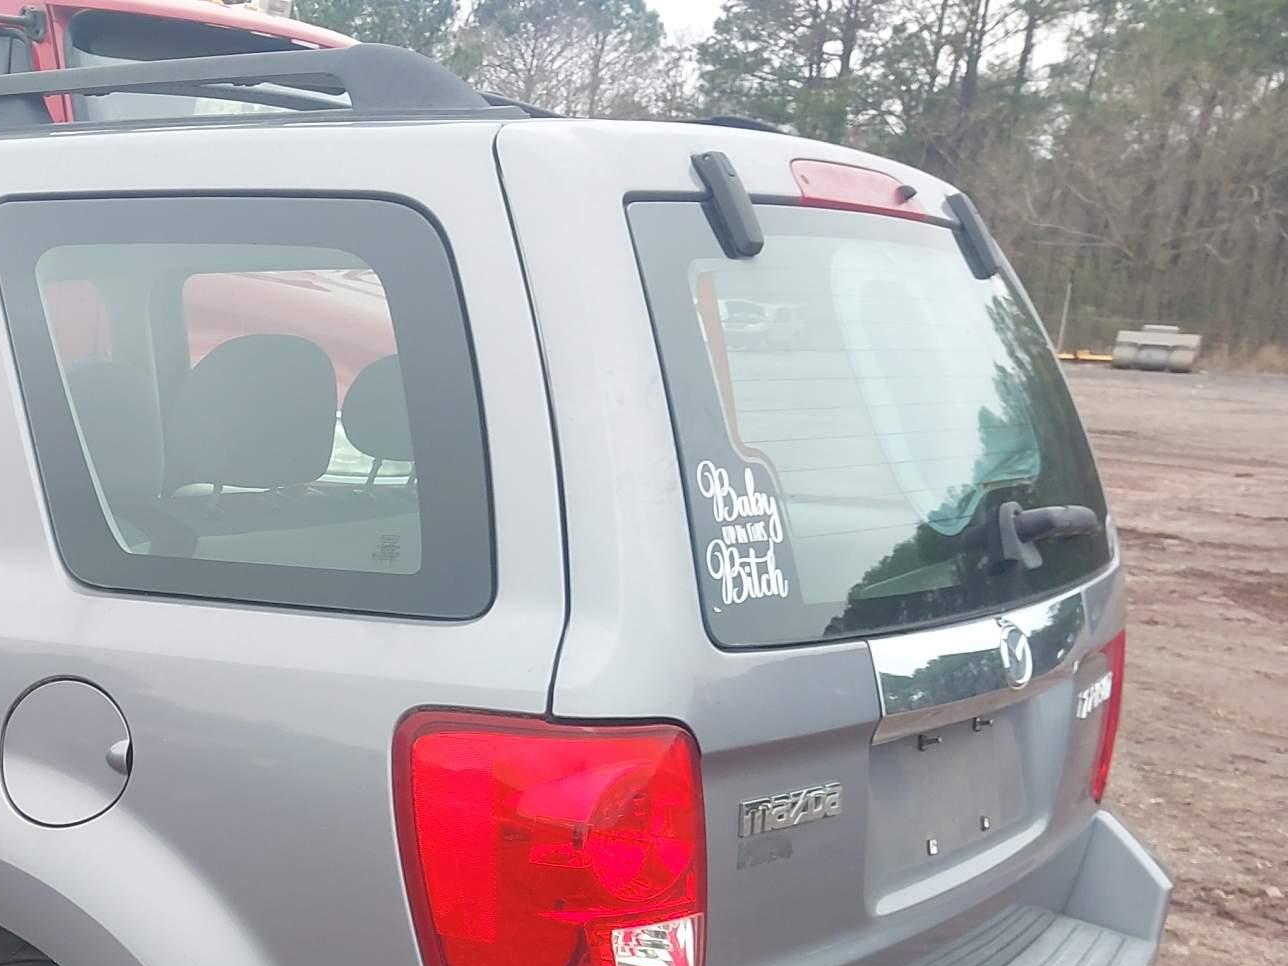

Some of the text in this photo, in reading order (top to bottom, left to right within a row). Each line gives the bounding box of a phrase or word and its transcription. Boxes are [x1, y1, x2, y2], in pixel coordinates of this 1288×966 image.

[697, 460, 783, 543] Baby
[706, 538, 789, 605] Bitch
[738, 782, 841, 838] mazda
